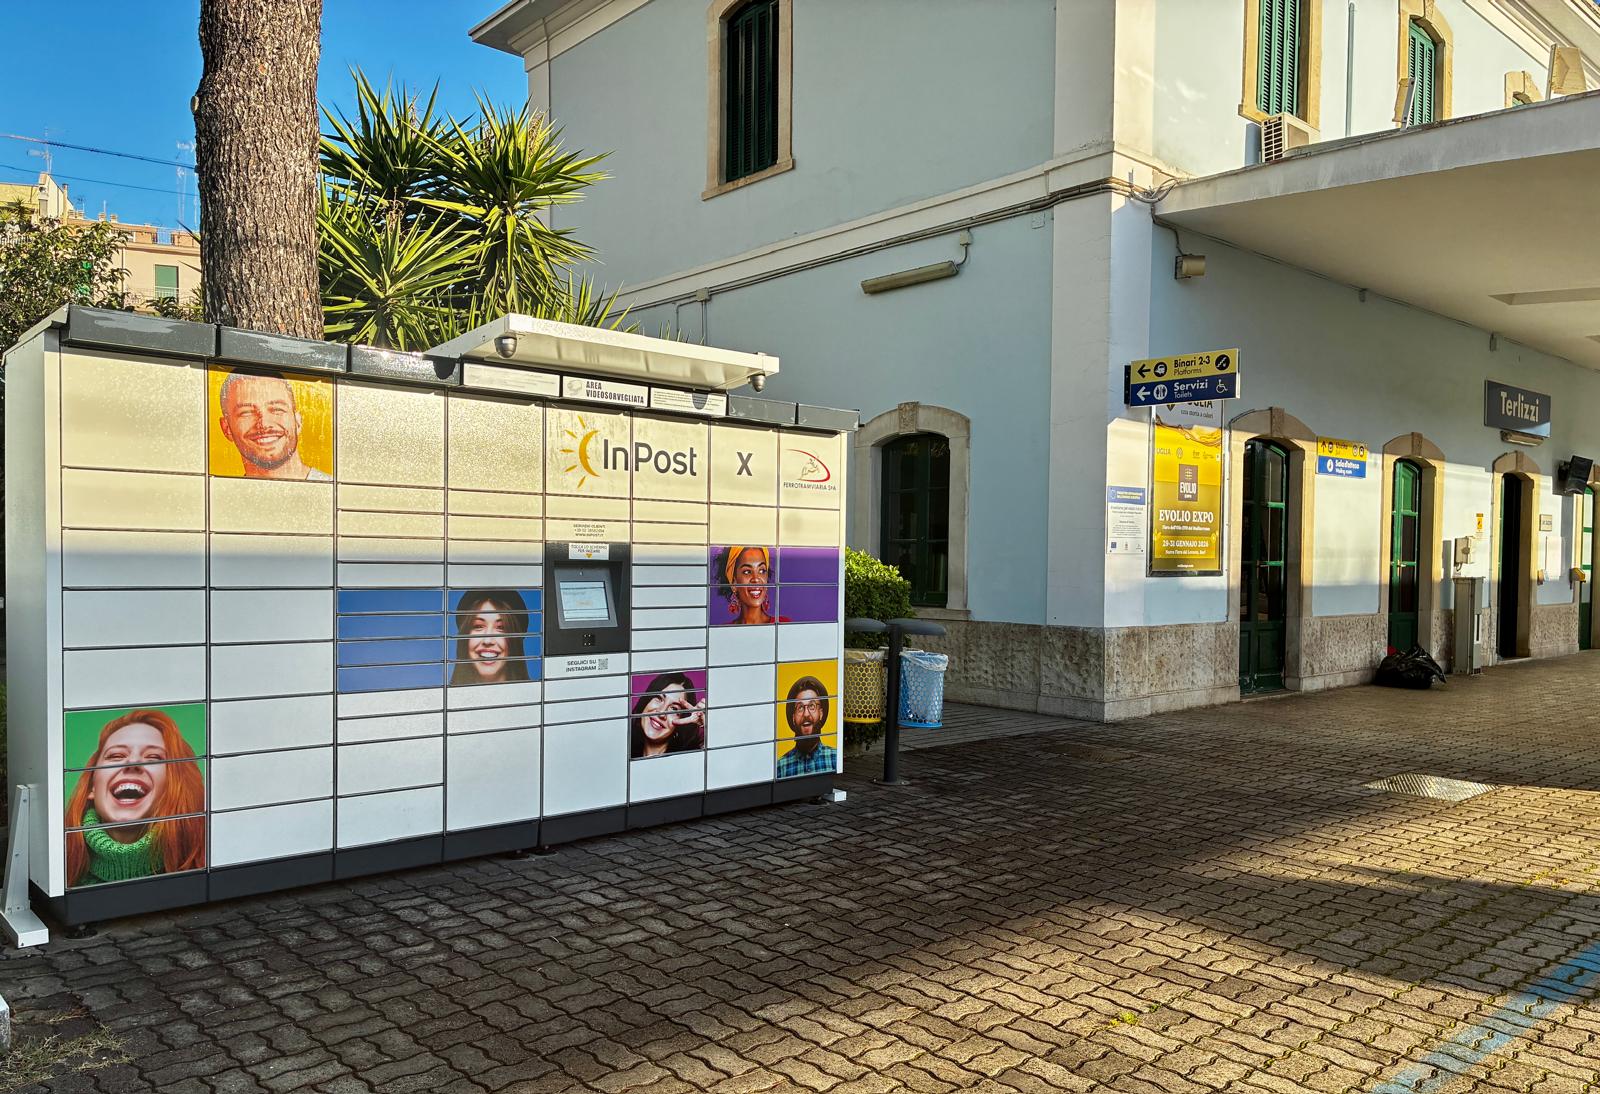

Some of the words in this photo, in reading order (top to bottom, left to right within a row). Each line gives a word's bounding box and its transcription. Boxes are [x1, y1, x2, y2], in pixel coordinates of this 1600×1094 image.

[1174, 357, 1196, 368] Binari
[1198, 355, 1211, 365] 2-3
[1174, 367, 1201, 376] Platforms
[586, 381, 602, 390] AREA
[1174, 379, 1208, 391] Servizi
[586, 390, 644, 404] VIDEOSORVEGLIATA
[1174, 391, 1192, 399] Toilets
[1500, 391, 1539, 422] Terlizzi
[603, 439, 697, 477] InPost
[1180, 482, 1197, 494] EVOLIO
[1159, 509, 1190, 522] EVOLIO
[1192, 511, 1214, 523] EXPO
